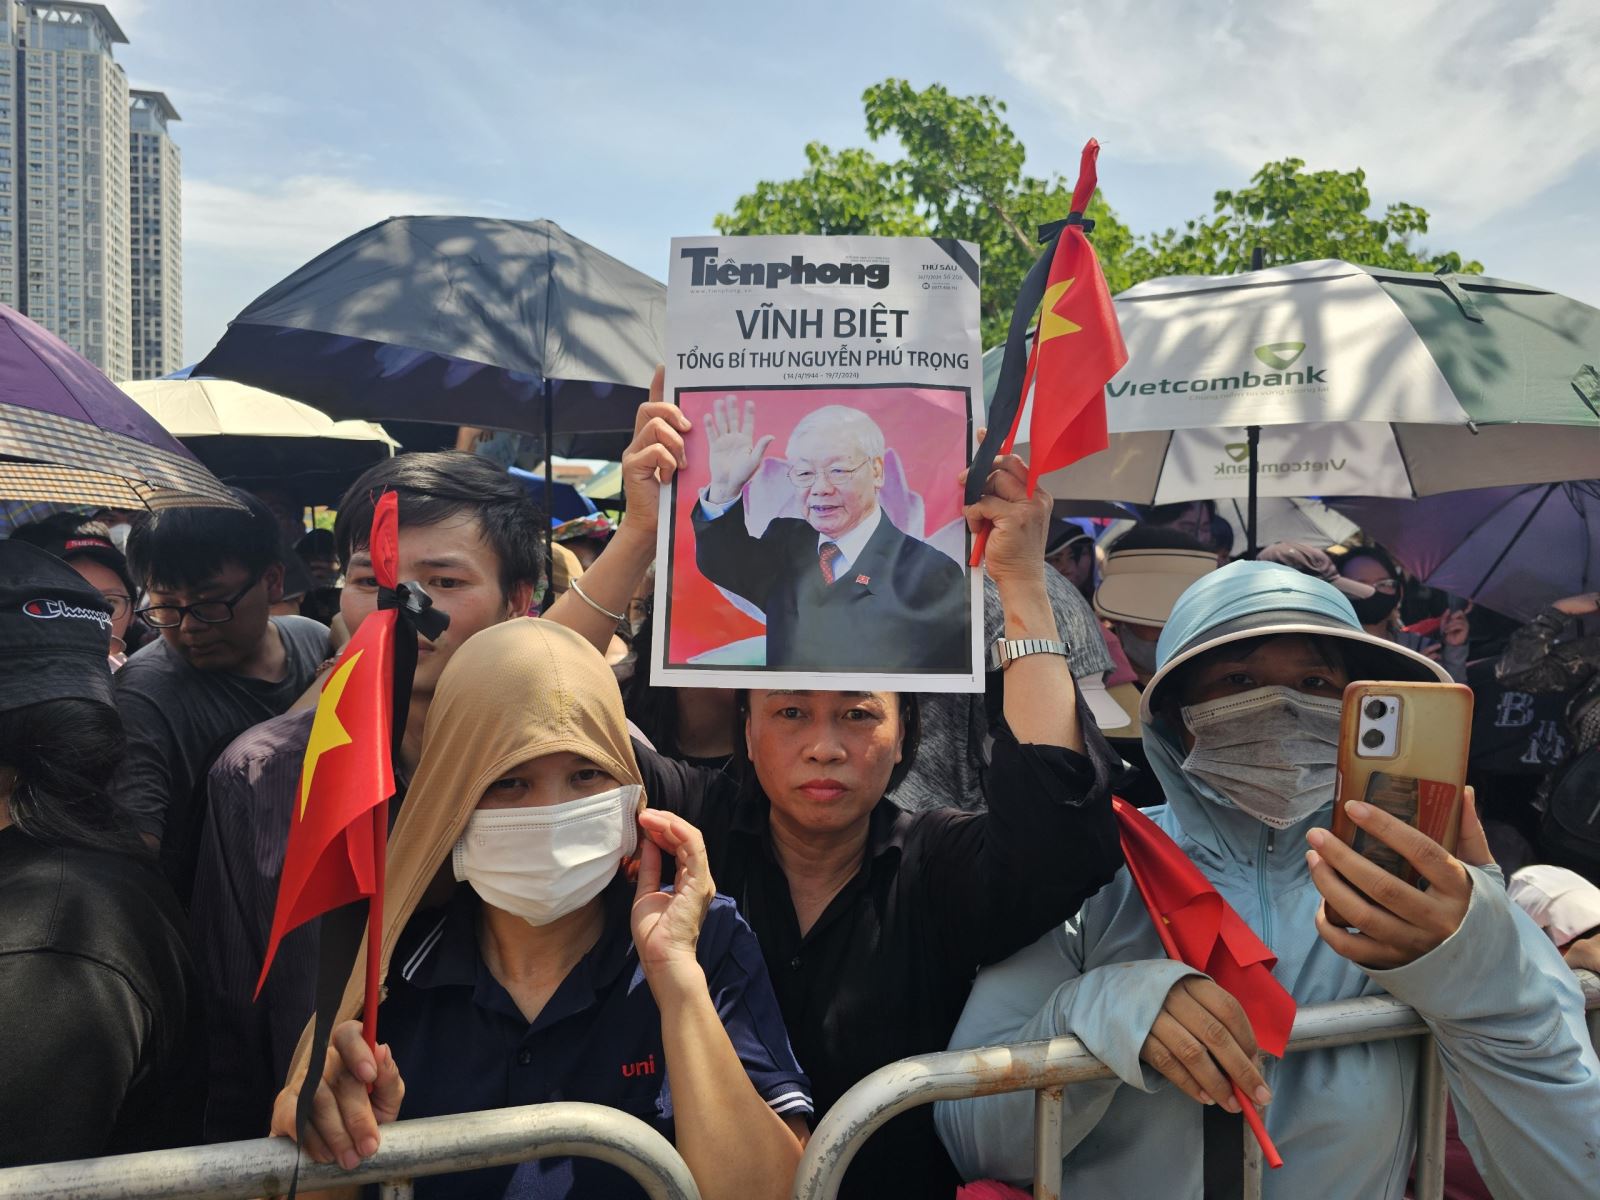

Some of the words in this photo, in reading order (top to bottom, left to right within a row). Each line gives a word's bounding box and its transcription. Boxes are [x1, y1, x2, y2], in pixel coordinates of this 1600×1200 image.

[736, 302, 823, 340] VĨNH
[834, 302, 909, 344] BIỆT
[677, 345, 723, 370] TỔNG
[729, 348, 746, 368] BÍ
[750, 350, 787, 368] THƯ
[788, 344, 864, 368] NGUYỄN
[866, 346, 904, 366] PHÚ
[907, 352, 969, 371] TRỌNG
[1106, 366, 1328, 398] Vietcombank
[621, 1054, 655, 1077] uni
